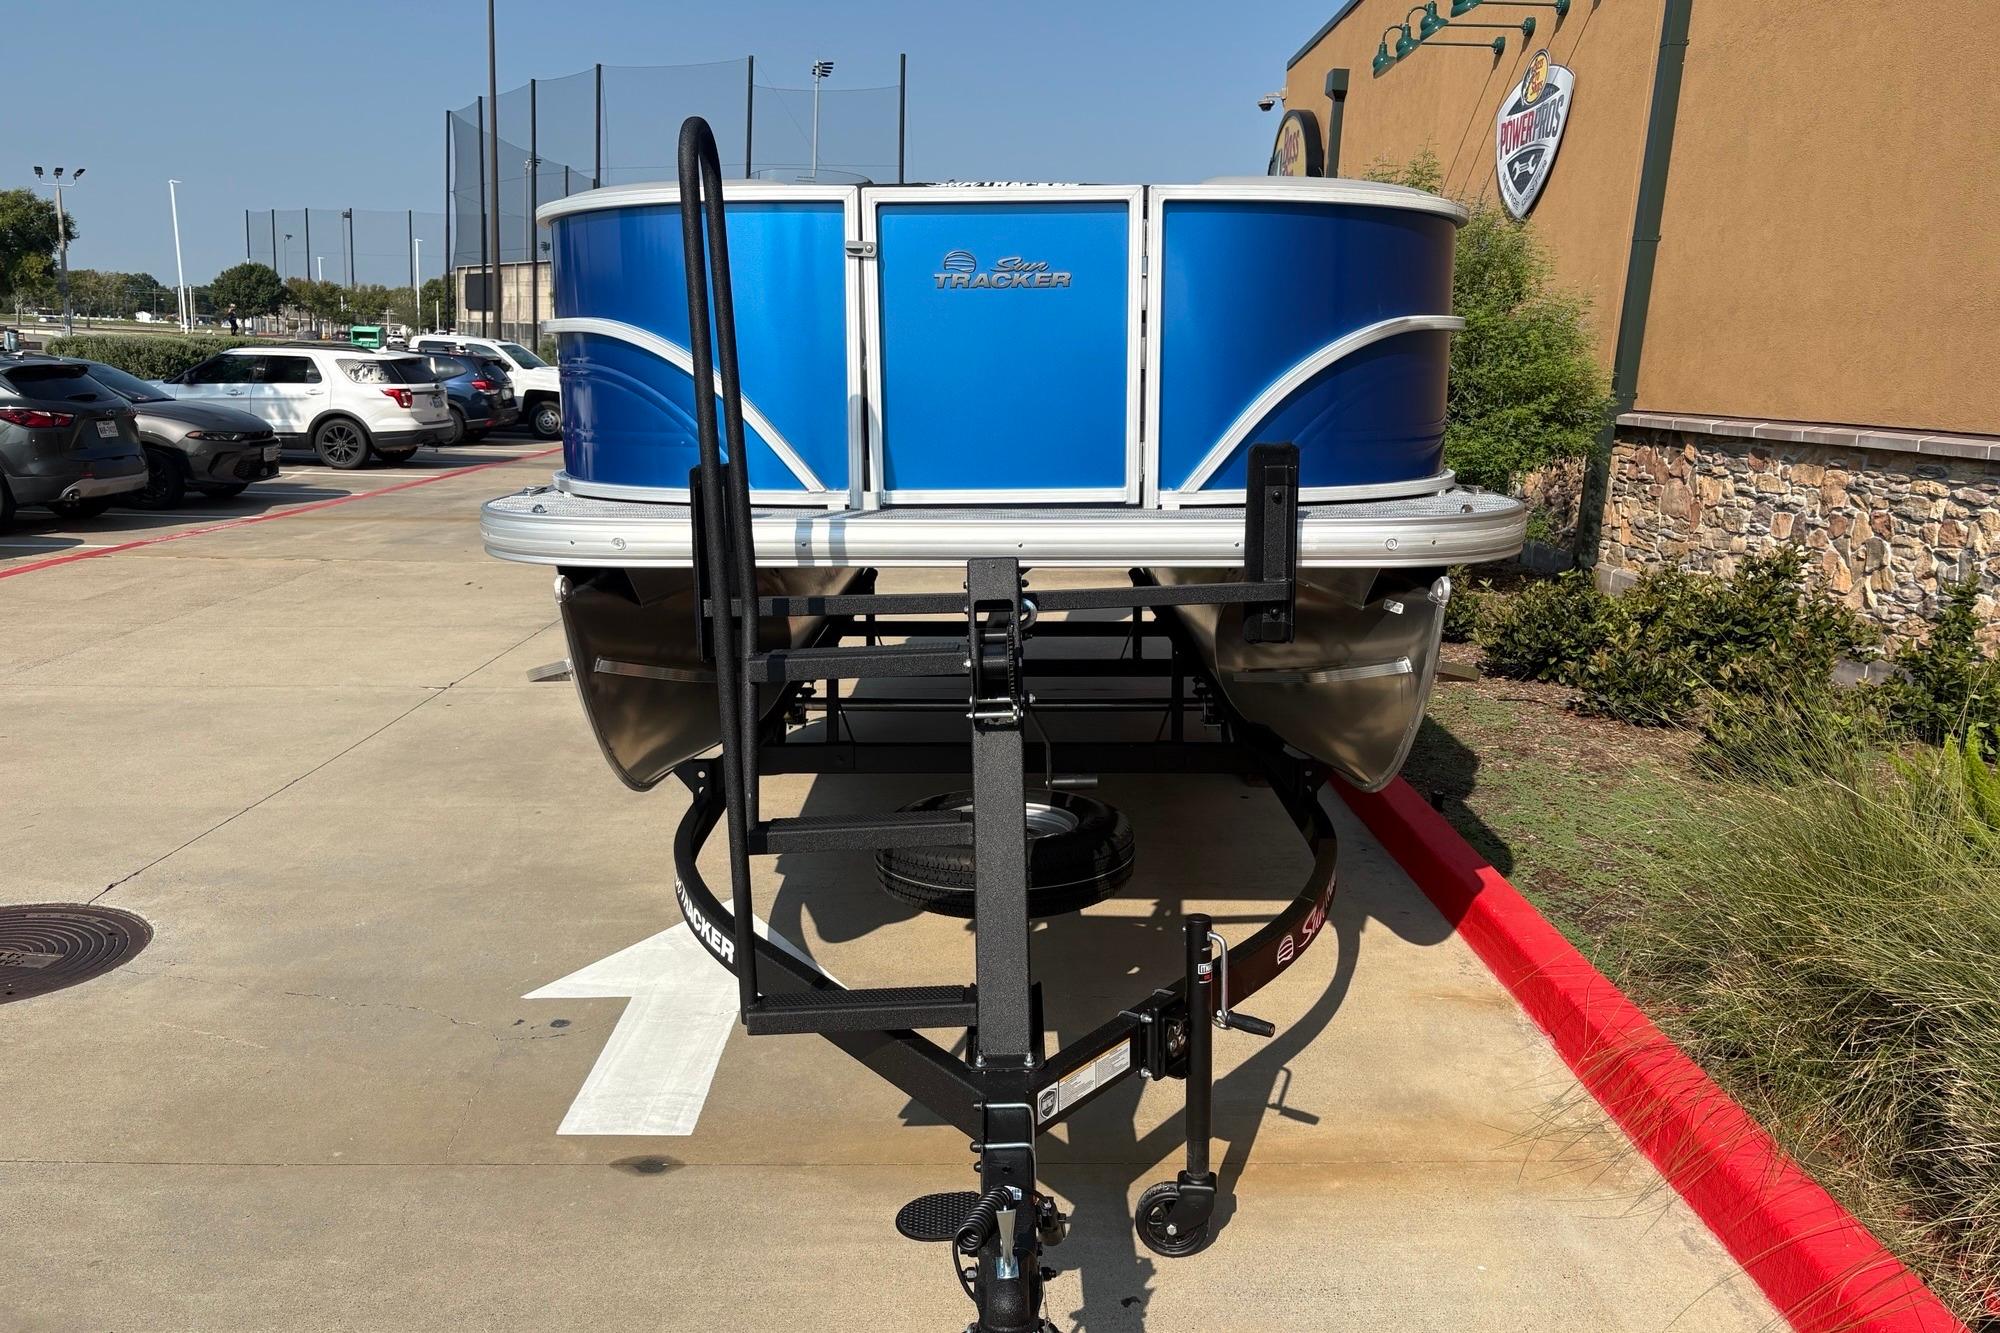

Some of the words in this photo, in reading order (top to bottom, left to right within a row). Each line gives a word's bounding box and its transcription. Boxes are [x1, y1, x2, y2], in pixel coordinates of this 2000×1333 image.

[1283, 127, 1299, 163] Bass
[1500, 94, 1564, 160] POWERPROS
[933, 272, 1072, 289] TRACKER
[990, 256, 1049, 273] Sun
[680, 880, 735, 964] TRACKER
